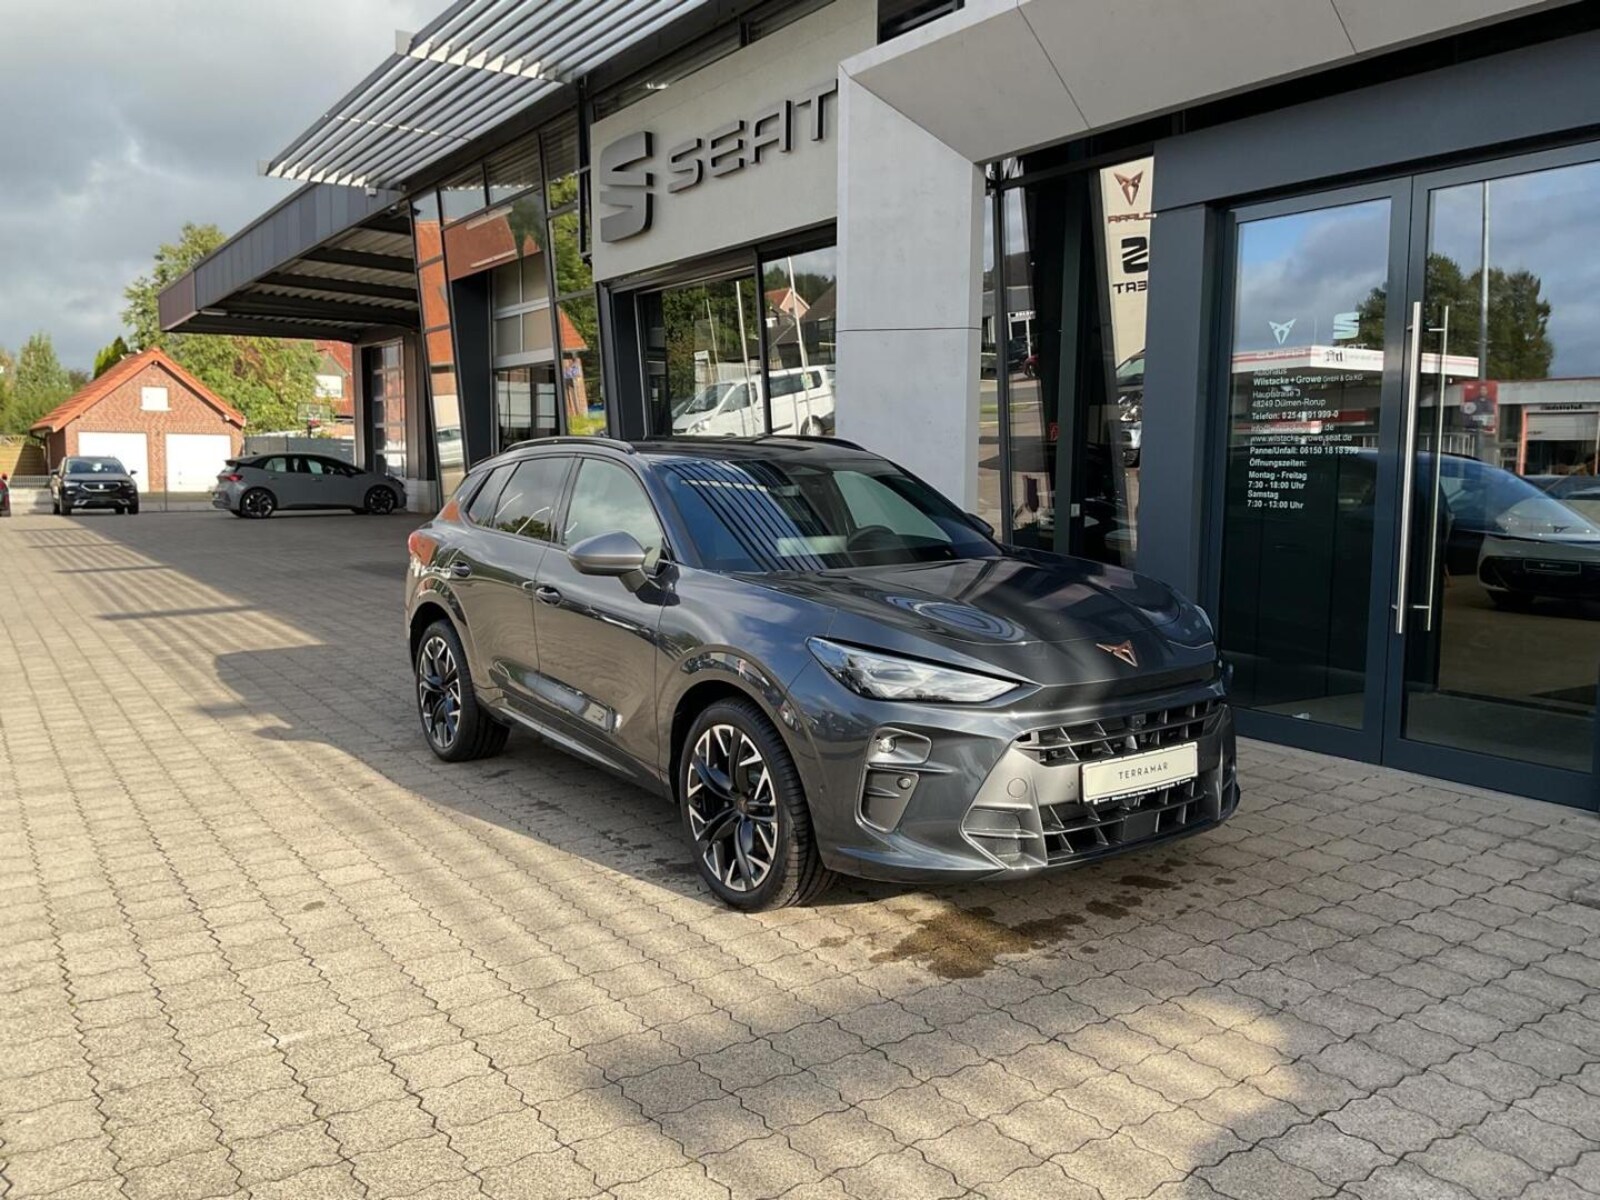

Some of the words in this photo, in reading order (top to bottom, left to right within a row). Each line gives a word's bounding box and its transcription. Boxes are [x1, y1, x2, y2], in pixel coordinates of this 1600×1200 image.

[668, 78, 838, 194] SEAT
[1296, 375, 1322, 384] Growe
[1252, 400, 1273, 408] 48249
[1252, 412, 1280, 420] Telefon:
[1249, 458, 1307, 468] Öffnungszeiten:
[1248, 471, 1276, 480] Montag
[1281, 471, 1307, 481] Freitag
[1270, 481, 1289, 489] 18:00
[1291, 481, 1305, 489] Uhr
[1247, 490, 1279, 499] Samstag
[1247, 500, 1262, 508] 7:30
[1269, 501, 1288, 509] 13:00
[1290, 501, 1304, 509] Uhr
[1118, 762, 1168, 780] TERRAMAR
